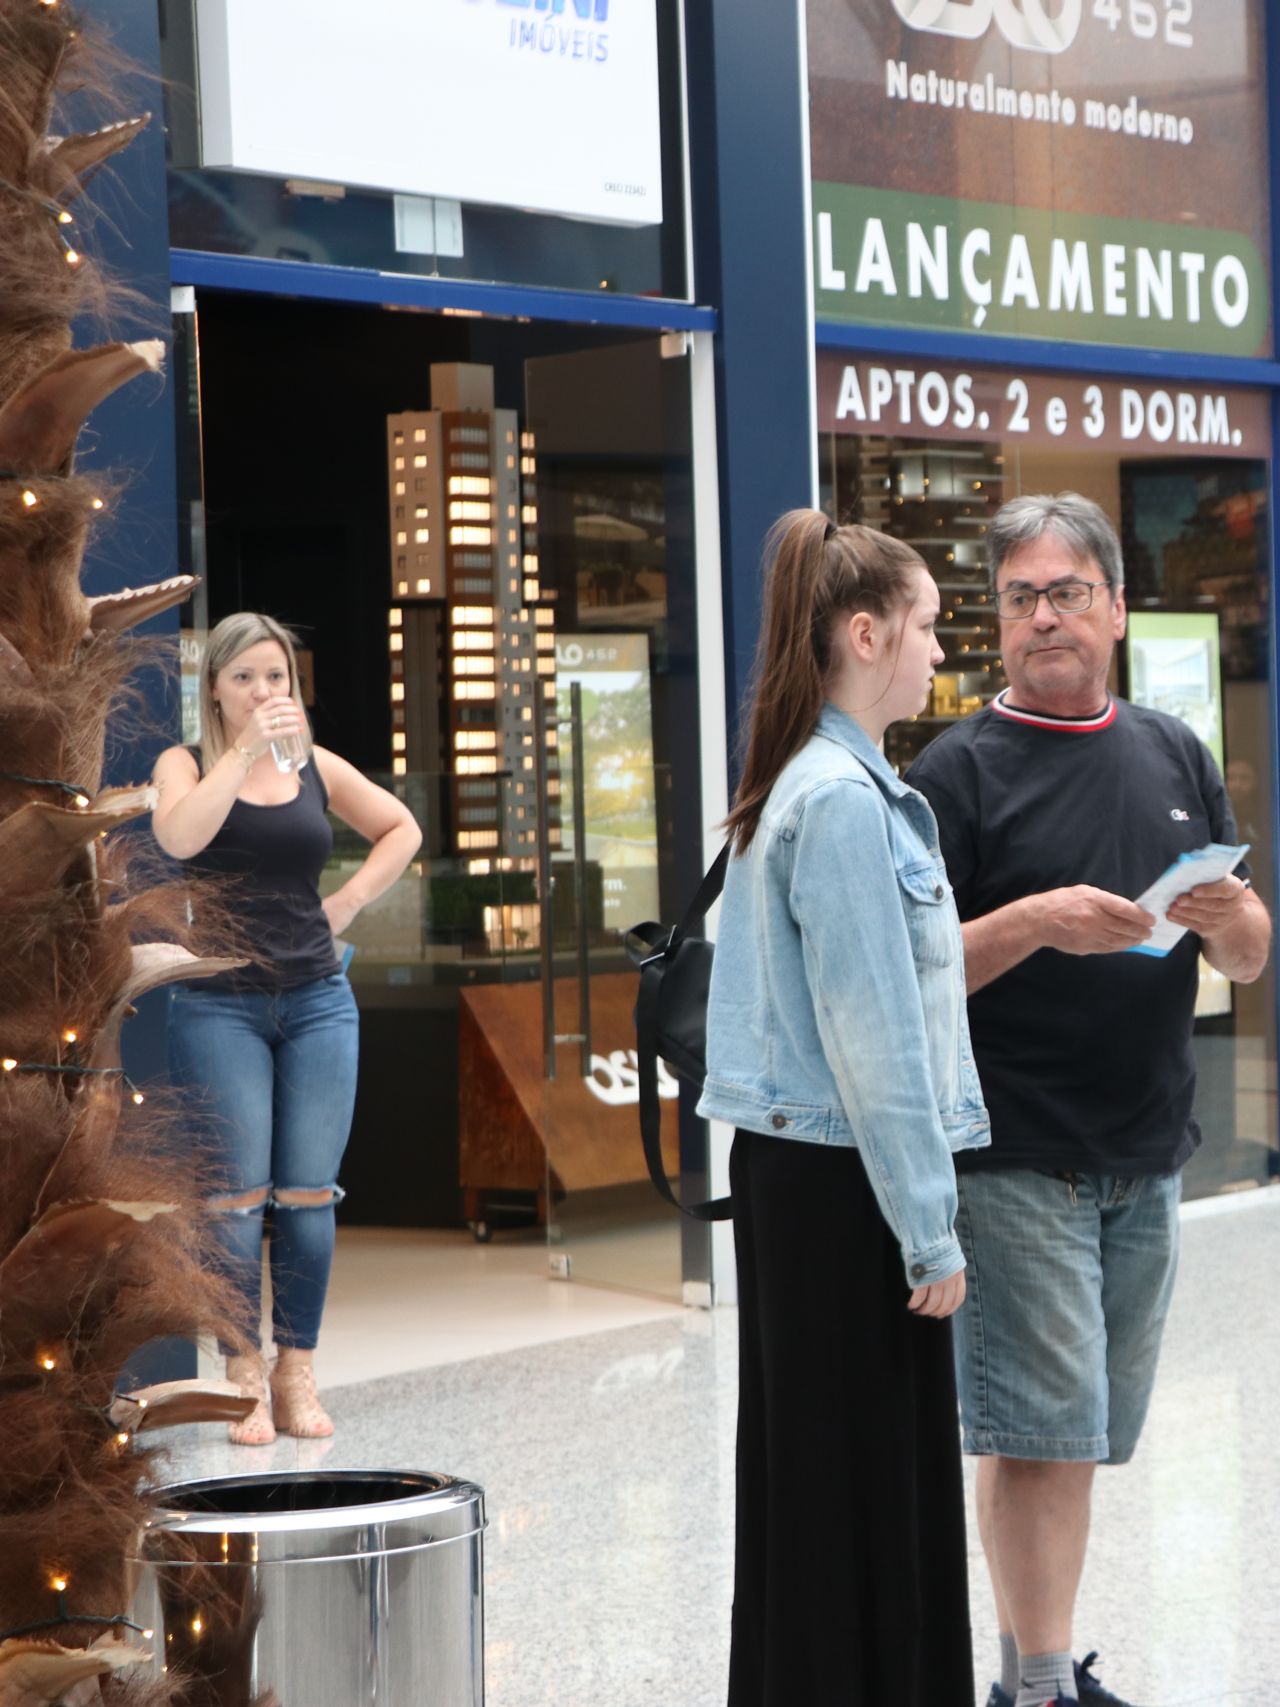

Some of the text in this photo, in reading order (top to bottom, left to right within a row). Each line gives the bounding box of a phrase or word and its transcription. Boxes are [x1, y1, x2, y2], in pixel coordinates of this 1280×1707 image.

[509, 14, 609, 62] IMÓVEIS
[886, 59, 1195, 144] Naturalmente moderno
[817, 211, 1250, 328] LANÇAMENTO
[836, 366, 1242, 446] APTOS. 2 e 3 DORM.
